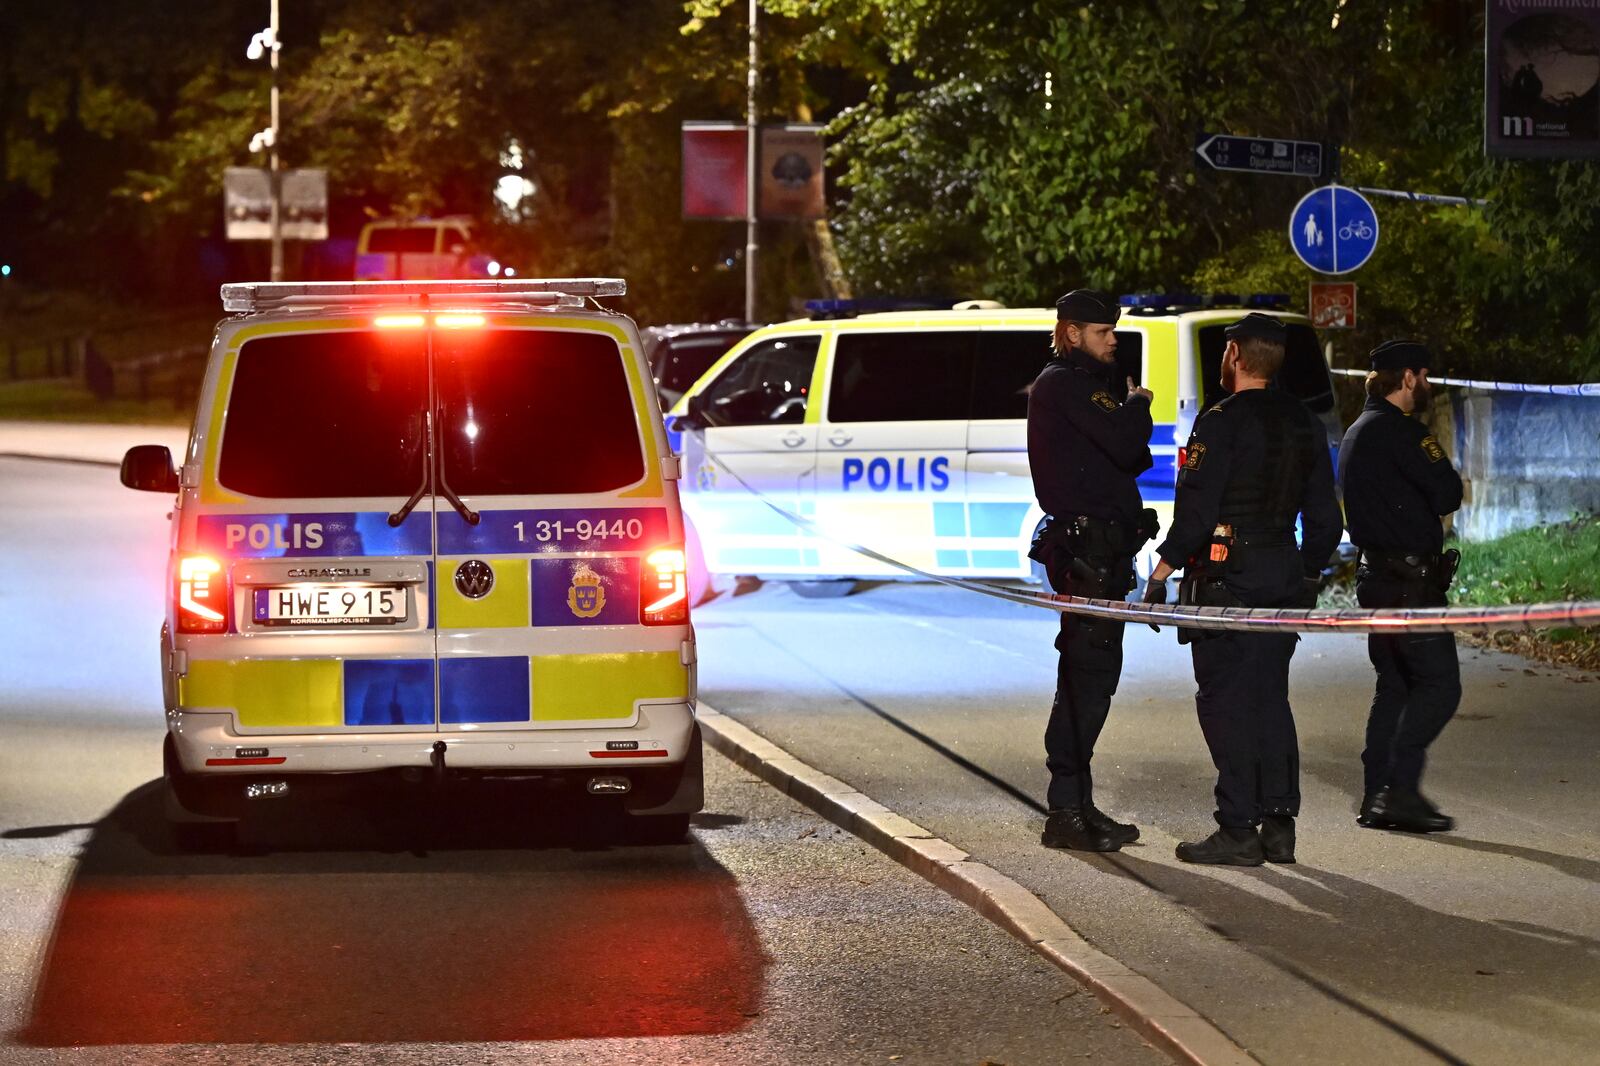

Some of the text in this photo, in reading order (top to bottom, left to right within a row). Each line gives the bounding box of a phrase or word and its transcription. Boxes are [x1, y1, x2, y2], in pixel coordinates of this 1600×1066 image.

[1536, 122, 1567, 130] national
[1249, 142, 1266, 156] City
[843, 456, 950, 492] POLIS
[226, 522, 324, 549] POLIS
[513, 518, 643, 541] 1 31-9440
[288, 568, 371, 578] CARAVELLE
[279, 591, 393, 616] HWE 915
[259, 607, 266, 616] S
[290, 617, 370, 625] NORRMALMSPOLISEN
